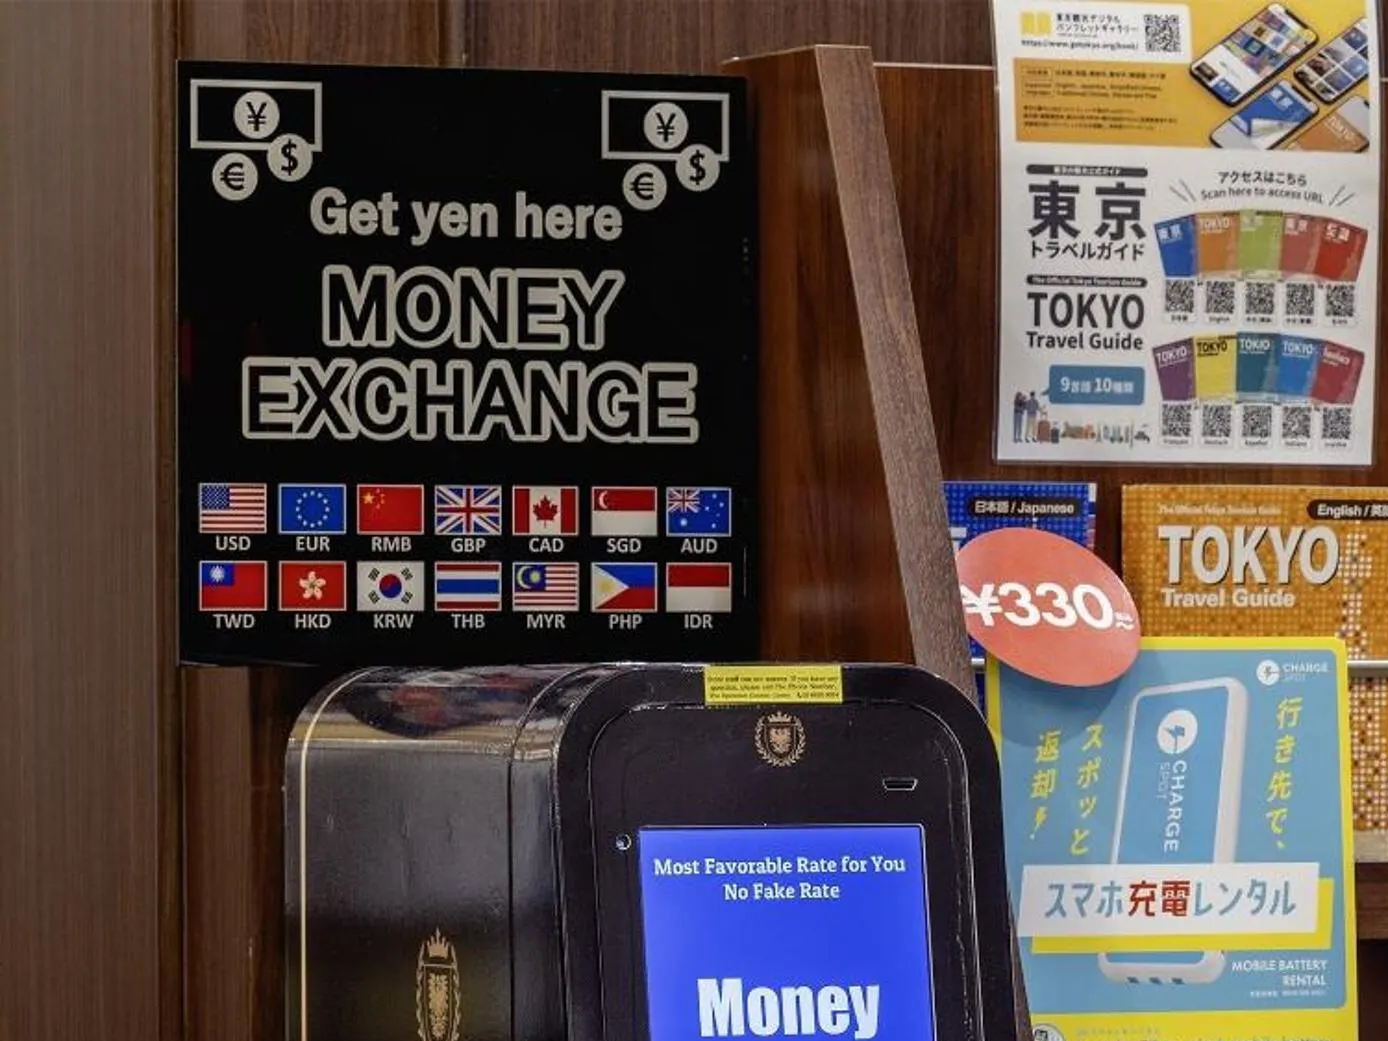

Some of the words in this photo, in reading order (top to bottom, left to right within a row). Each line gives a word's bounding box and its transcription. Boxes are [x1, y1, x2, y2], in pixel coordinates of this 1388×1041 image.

[1218, 171, 1308, 187] アクセスはこちら
[1201, 189, 1226, 201] Scan
[1228, 186, 1251, 198] here
[1254, 187, 1265, 197] to
[1268, 188, 1302, 199] access
[1304, 190, 1324, 204] URL
[310, 187, 399, 237] Get
[411, 201, 498, 246] yen
[515, 191, 623, 241] here
[1028, 180, 1147, 240] 東京
[1032, 240, 1145, 261] トラベルガイド
[323, 265, 625, 350] MONEY
[1027, 292, 1144, 330] TOKYO
[1026, 332, 1083, 350] Travel
[1088, 332, 1144, 351] Guide
[1197, 340, 1228, 354] TOKYO
[1156, 345, 1187, 363] TOKYO
[242, 357, 699, 443] EXCHANGE
[1017, 501, 1075, 515] Japanese
[1317, 503, 1362, 518] English
[215, 535, 251, 552] USD
[296, 535, 330, 552] EUR
[371, 535, 412, 553] RMB
[451, 536, 486, 553] GBP
[528, 536, 564, 553] CAD
[606, 537, 641, 554] SGD
[680, 537, 717, 554] AUD
[1158, 525, 1340, 585] TOKYO
[960, 581, 1114, 630] ¥330
[1161, 588, 1225, 607] Travel
[1231, 588, 1296, 608] Guide
[213, 613, 255, 630] TWD
[295, 613, 331, 630] HKD
[373, 613, 414, 630] KRW
[451, 613, 485, 630] THB
[527, 613, 565, 630] MYR
[608, 614, 642, 630] PHP
[684, 614, 713, 630] IDR
[1282, 662, 1329, 673] CHARGE
[1070, 723, 1103, 857] スポッと
[1163, 760, 1188, 853] CHARGE
[654, 858, 700, 876] Most
[704, 856, 793, 875] Favorable
[796, 857, 838, 874] Rate
[840, 856, 867, 874] for
[870, 855, 906, 874] You
[724, 883, 749, 901] No
[753, 882, 796, 901] Fake
[799, 882, 840, 900] Rate
[1044, 880, 1297, 919] スマホ充電レンタル
[1231, 960, 1277, 972] MOBILE
[1278, 959, 1328, 972] BATTERY
[1282, 975, 1327, 987] RENTAL
[697, 977, 881, 1041] Money
